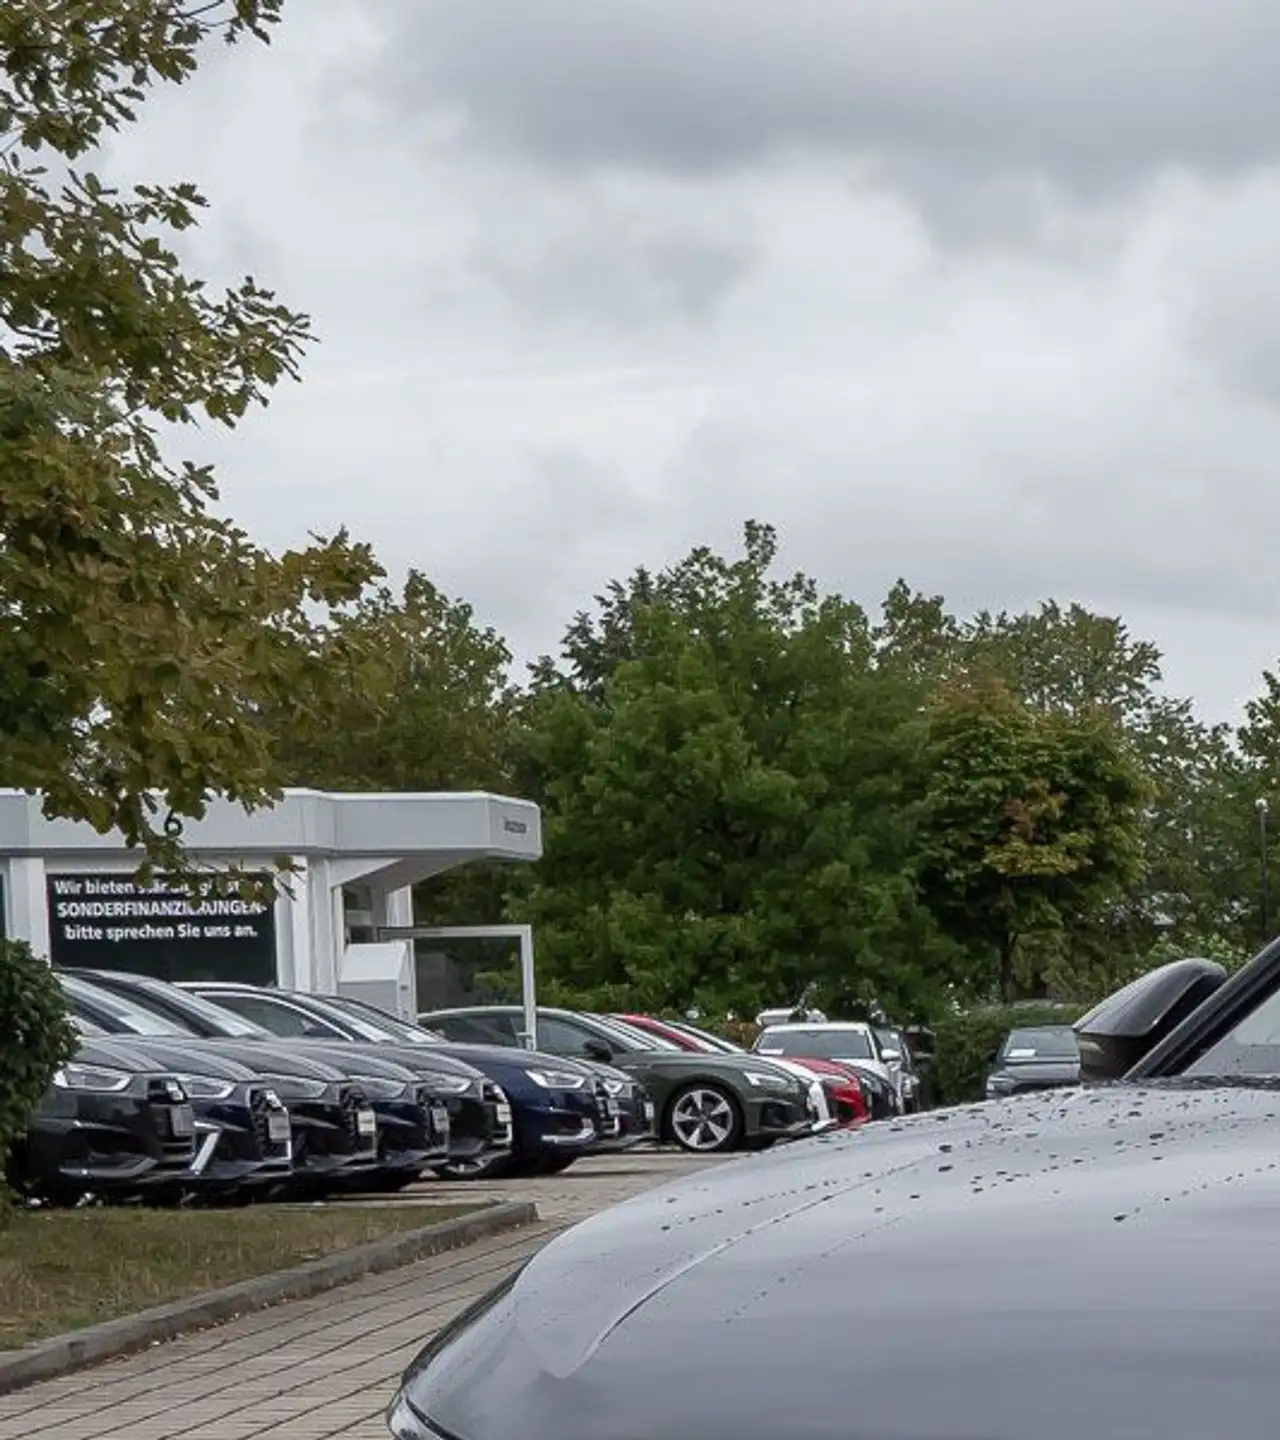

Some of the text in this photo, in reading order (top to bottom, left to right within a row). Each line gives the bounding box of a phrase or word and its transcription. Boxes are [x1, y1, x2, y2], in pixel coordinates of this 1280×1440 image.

[55, 880, 82, 894] Wir
[85, 879, 135, 894] bieten
[65, 924, 103, 940] bitte
[106, 924, 174, 942] sprechen
[177, 923, 200, 938] Sie
[204, 926, 231, 938] uns
